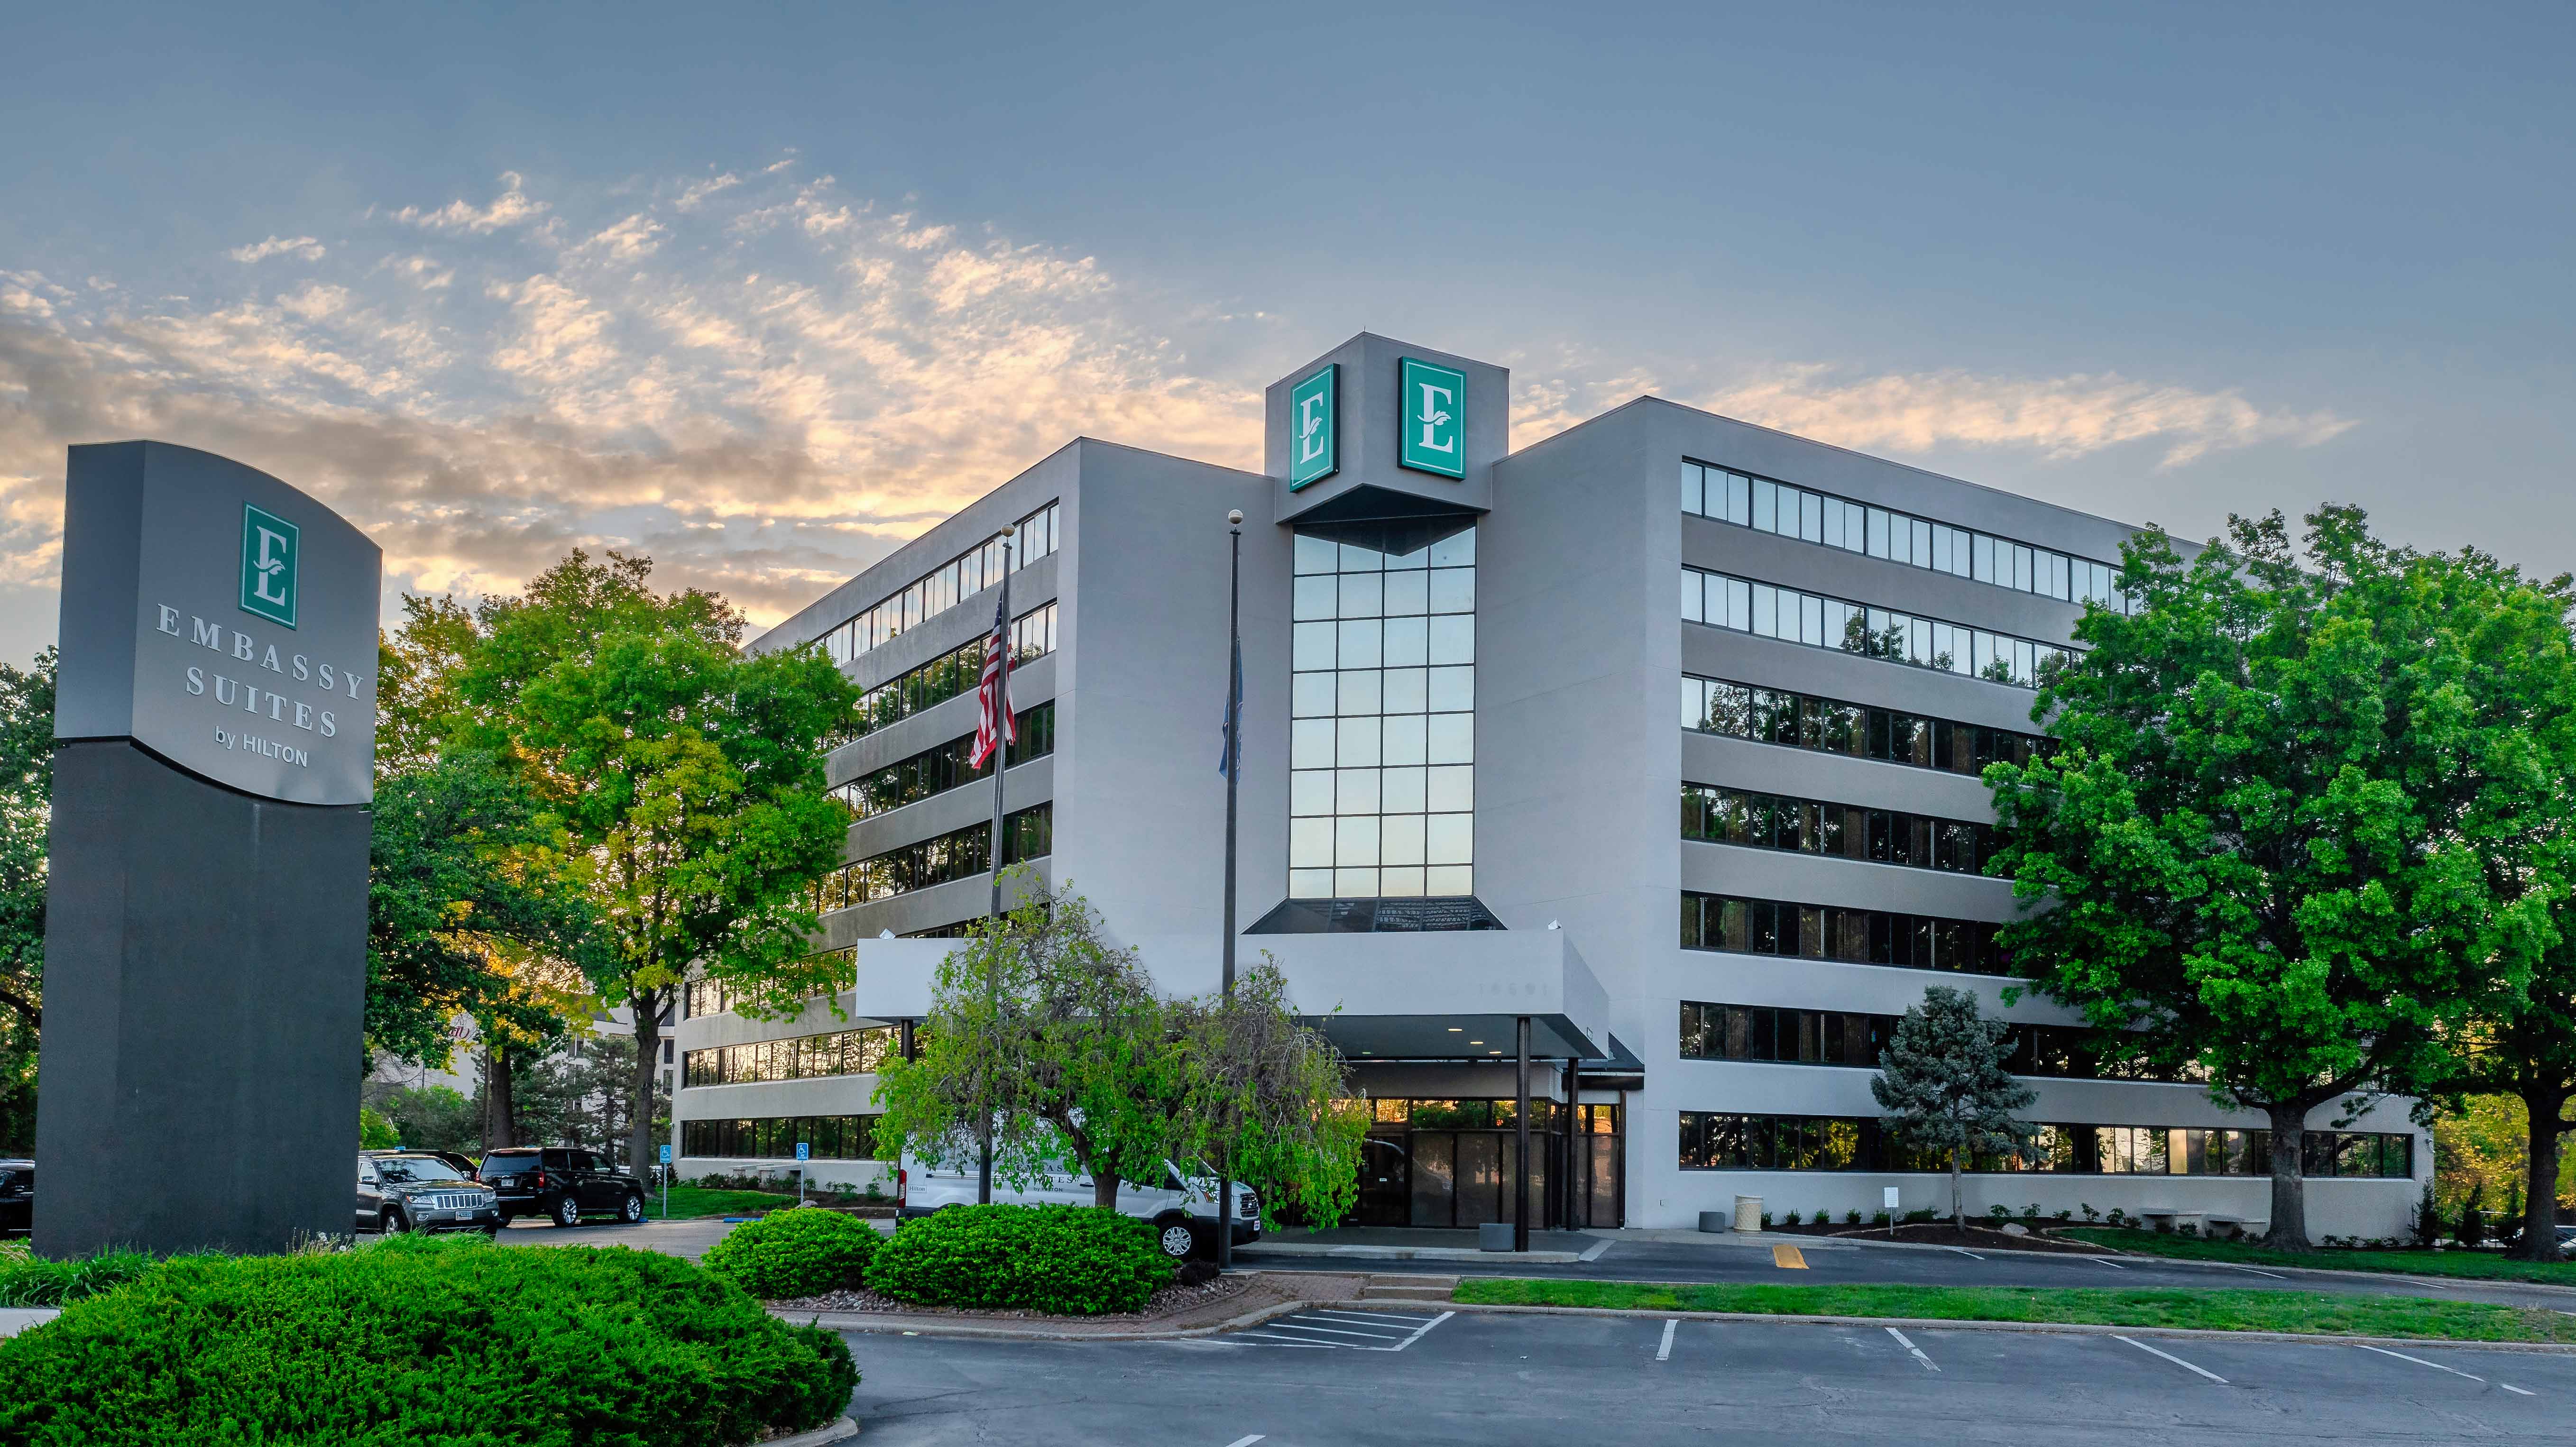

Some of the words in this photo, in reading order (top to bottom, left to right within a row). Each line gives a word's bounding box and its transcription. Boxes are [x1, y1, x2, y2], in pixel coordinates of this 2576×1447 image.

[156, 603, 364, 700] EMBASSY
[185, 667, 337, 738] SUITES
[215, 725, 236, 750] by
[243, 733, 307, 768] HILTON
